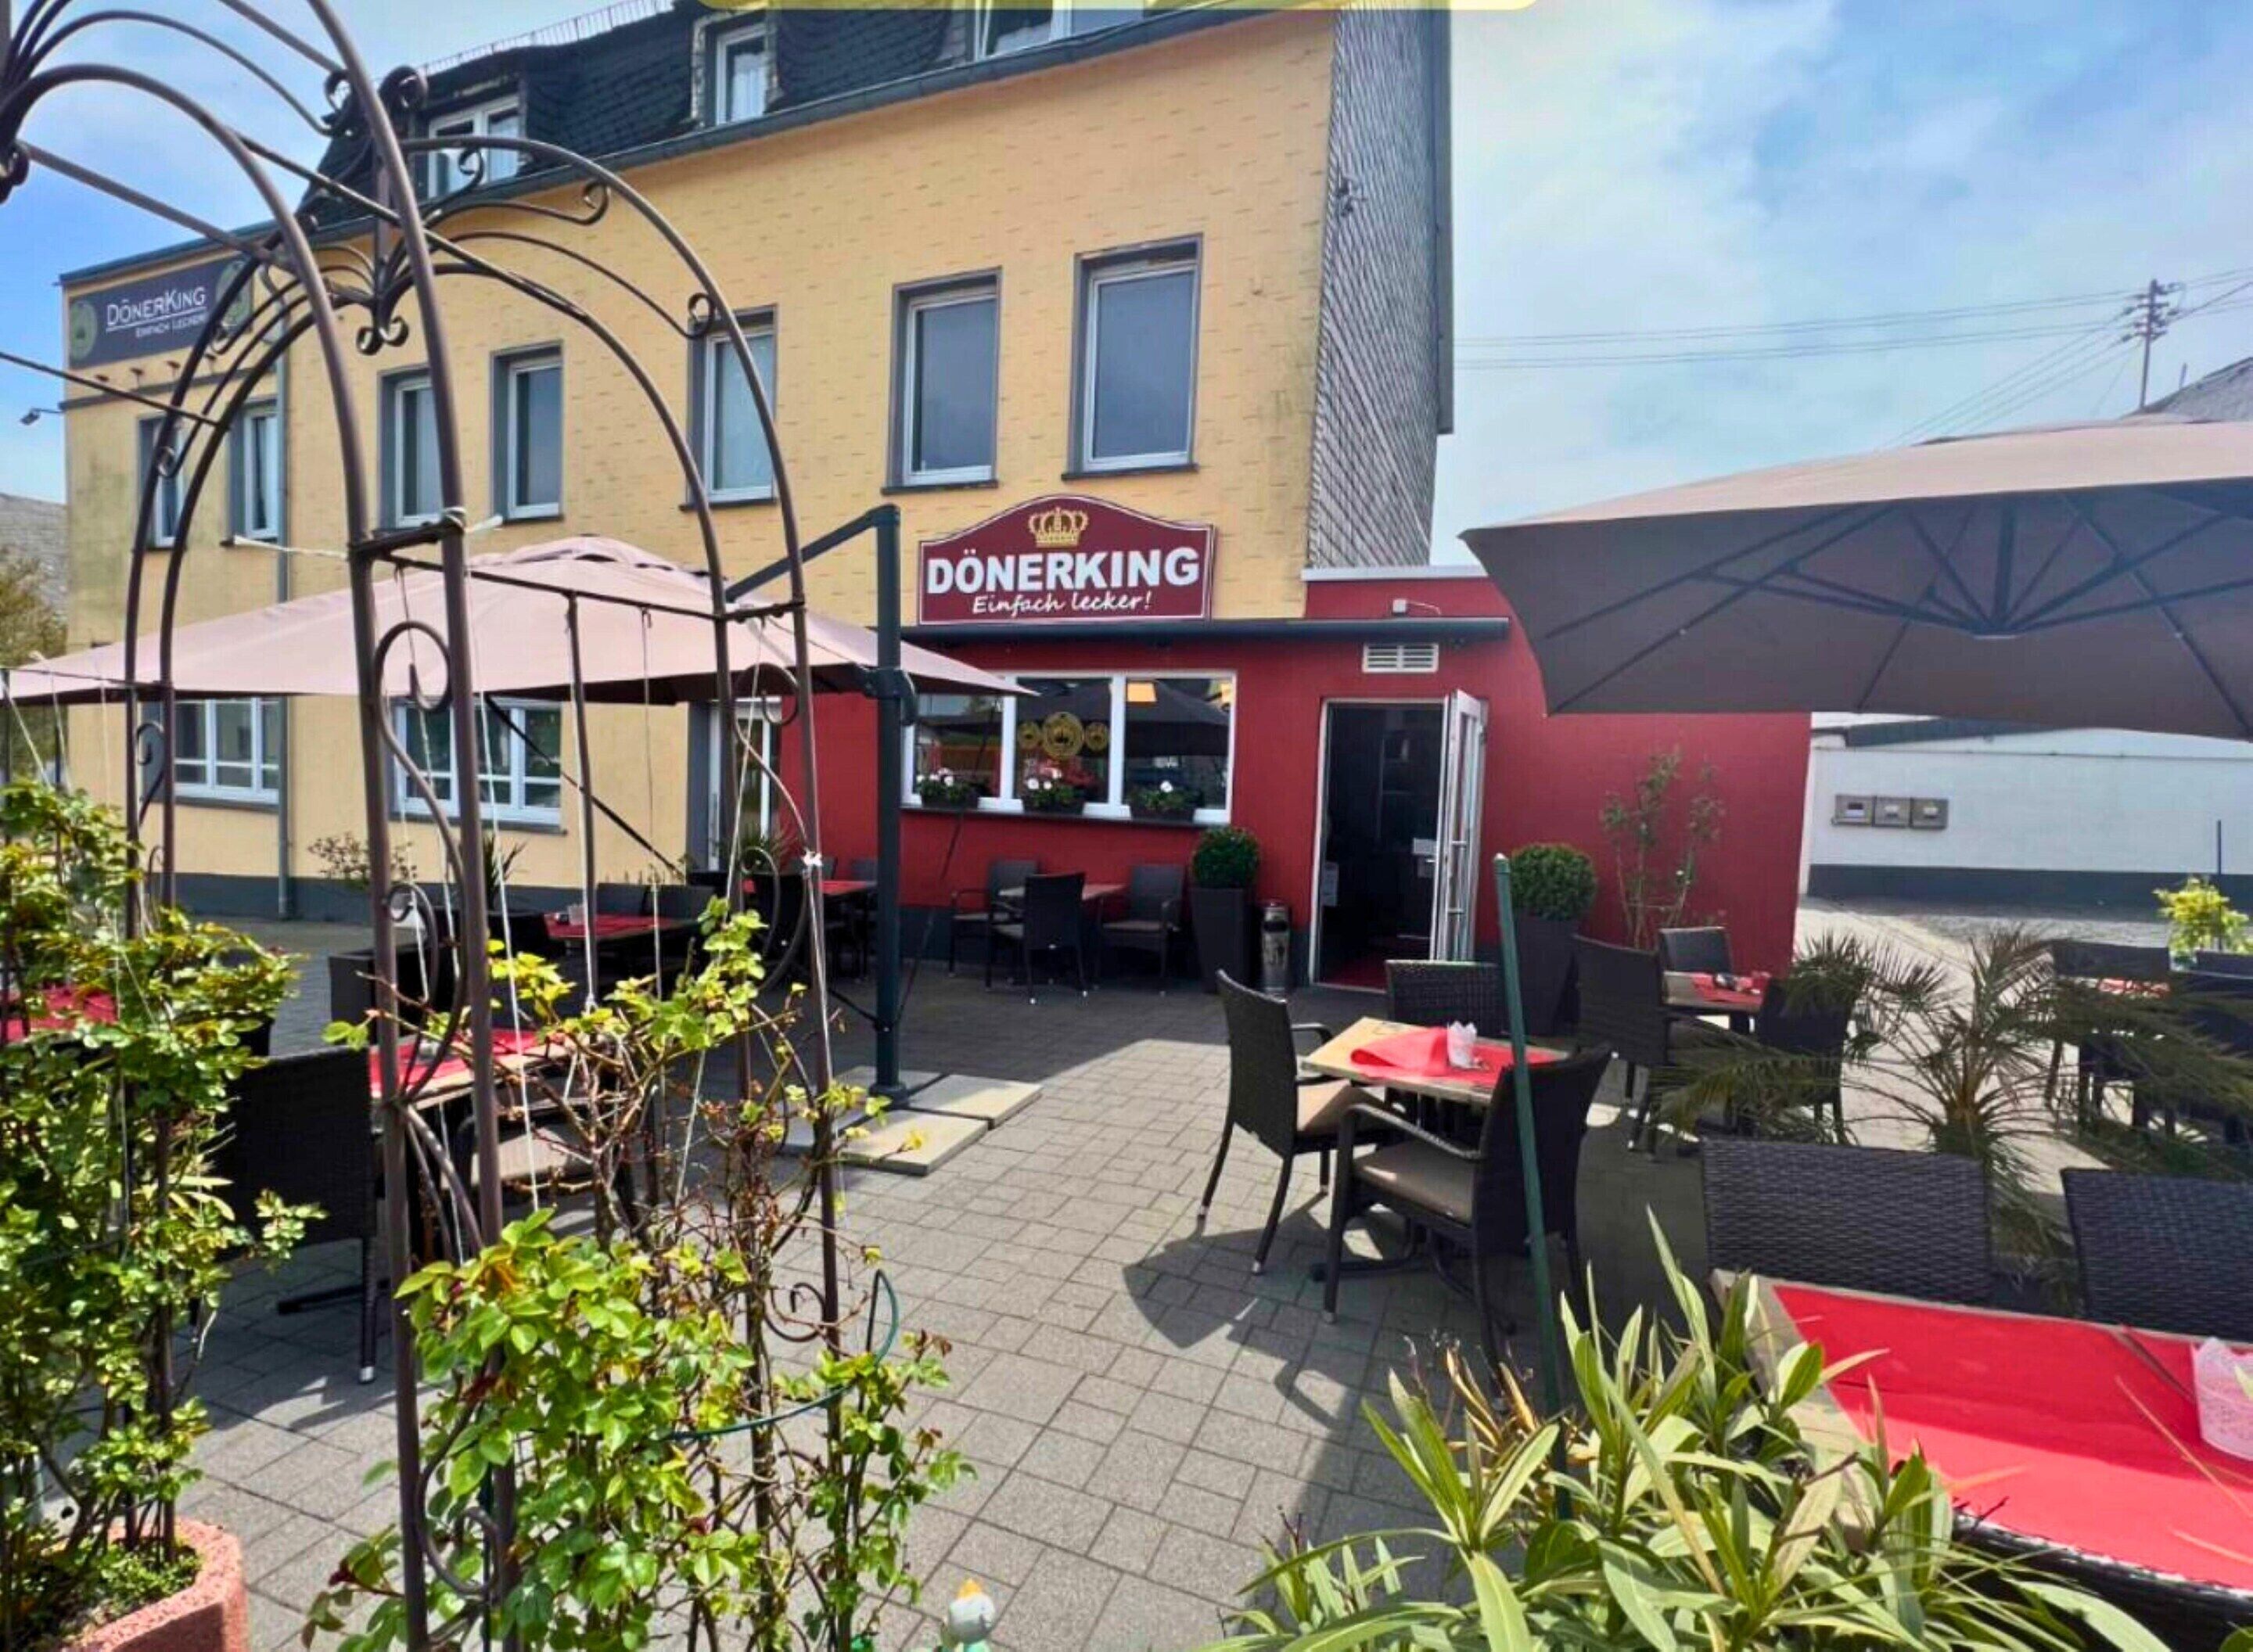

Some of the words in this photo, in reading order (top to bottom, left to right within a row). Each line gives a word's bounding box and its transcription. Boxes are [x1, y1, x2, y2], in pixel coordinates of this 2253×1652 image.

[927, 548, 1200, 594] DÖNERKING
[972, 593, 1065, 616] Einfach
[1071, 591, 1153, 612] lecker!
